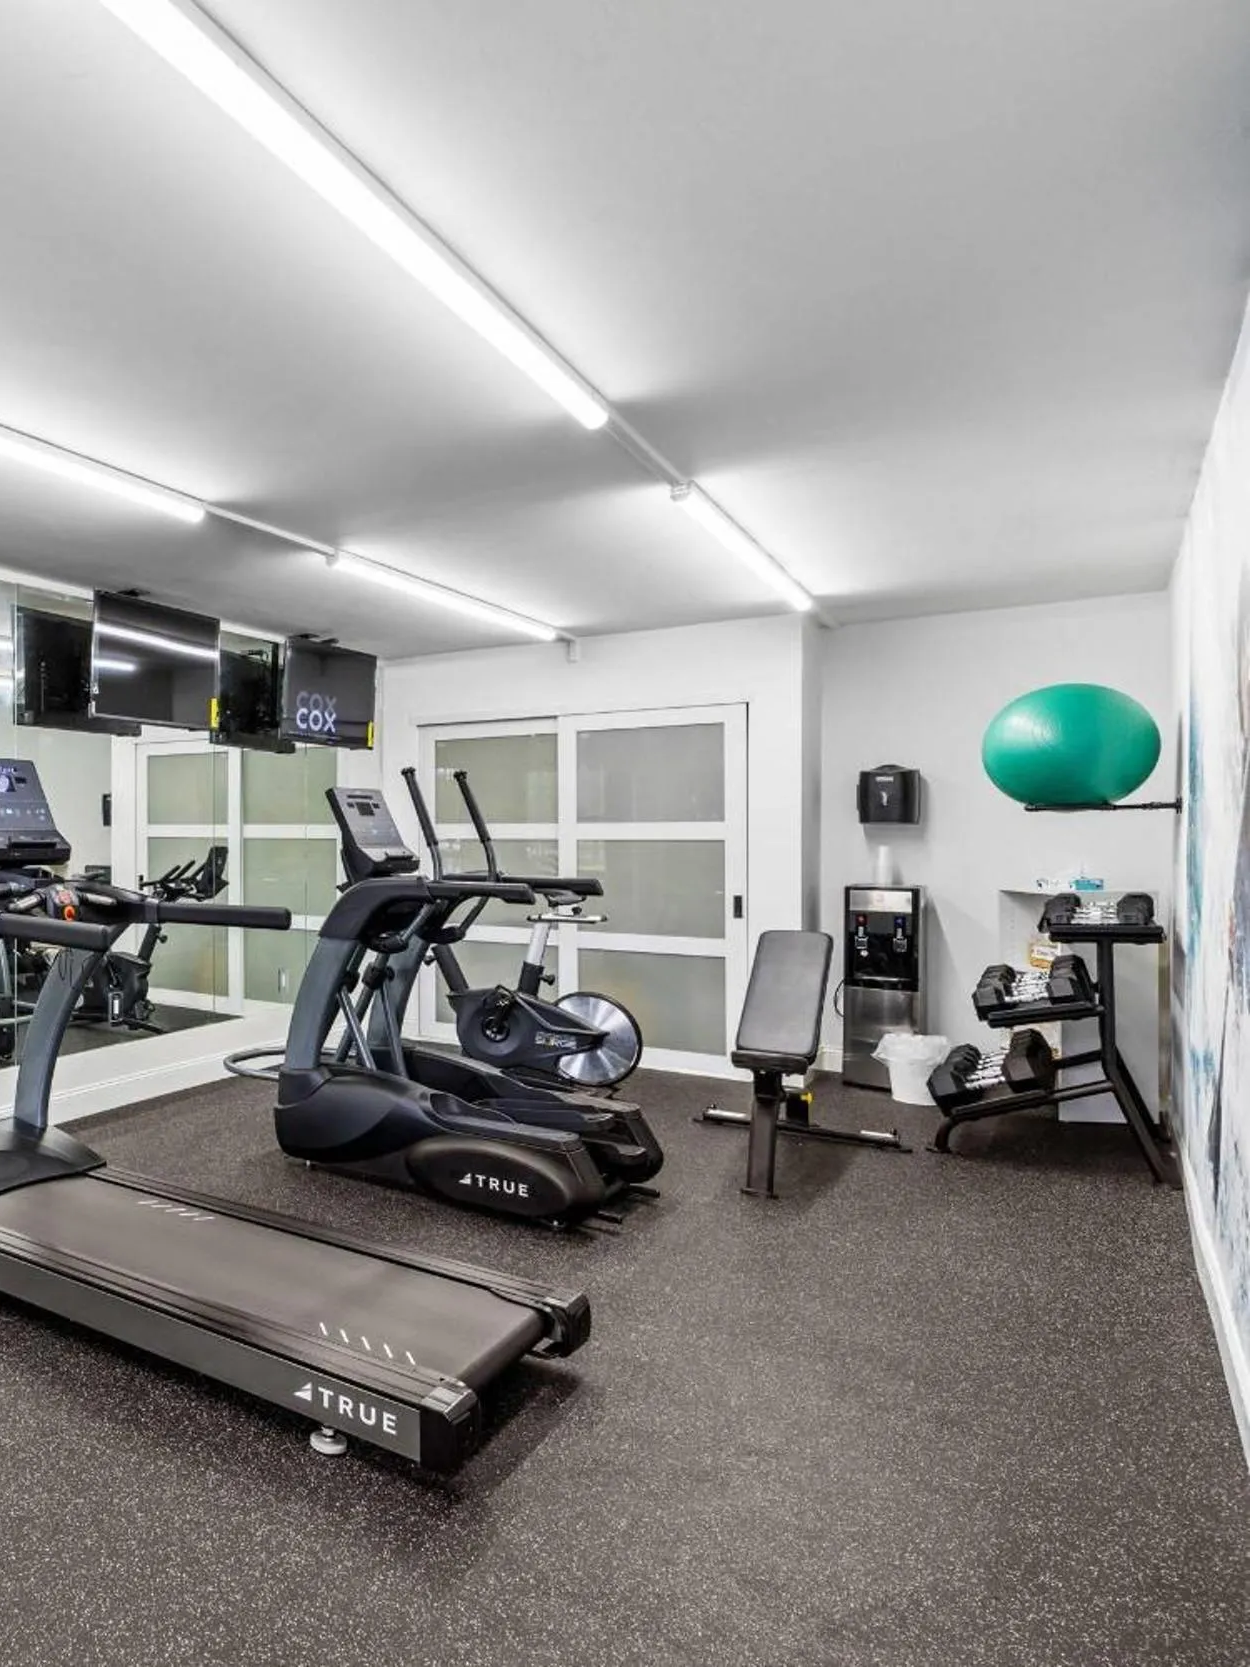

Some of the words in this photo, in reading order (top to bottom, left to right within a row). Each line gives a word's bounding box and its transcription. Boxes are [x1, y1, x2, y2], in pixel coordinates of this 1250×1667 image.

[296, 707, 336, 733] COX
[475, 1174, 528, 1197] TRUE
[317, 1386, 398, 1436] TRUE
